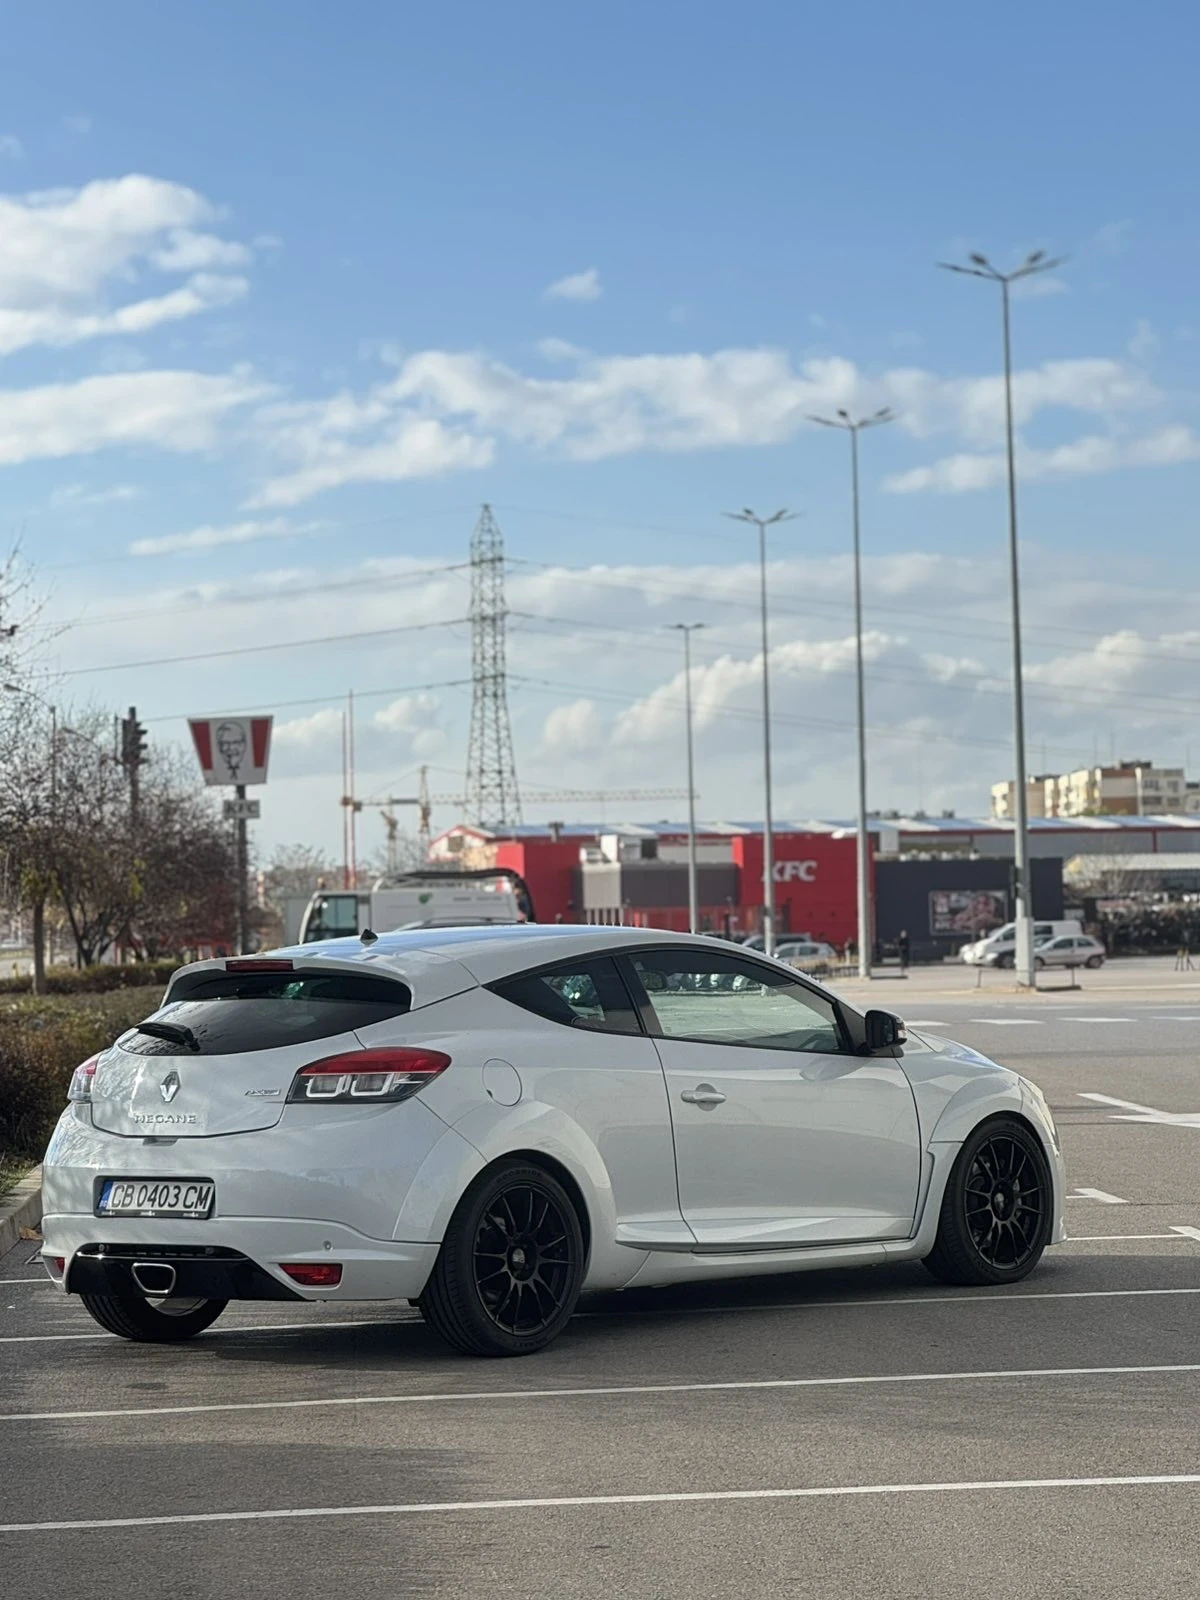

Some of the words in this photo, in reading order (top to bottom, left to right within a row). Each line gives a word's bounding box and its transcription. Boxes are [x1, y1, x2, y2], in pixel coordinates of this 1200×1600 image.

[111, 1184, 136, 1208] CB
[136, 1184, 182, 1208] 0403
[183, 1185, 212, 1210] CM
